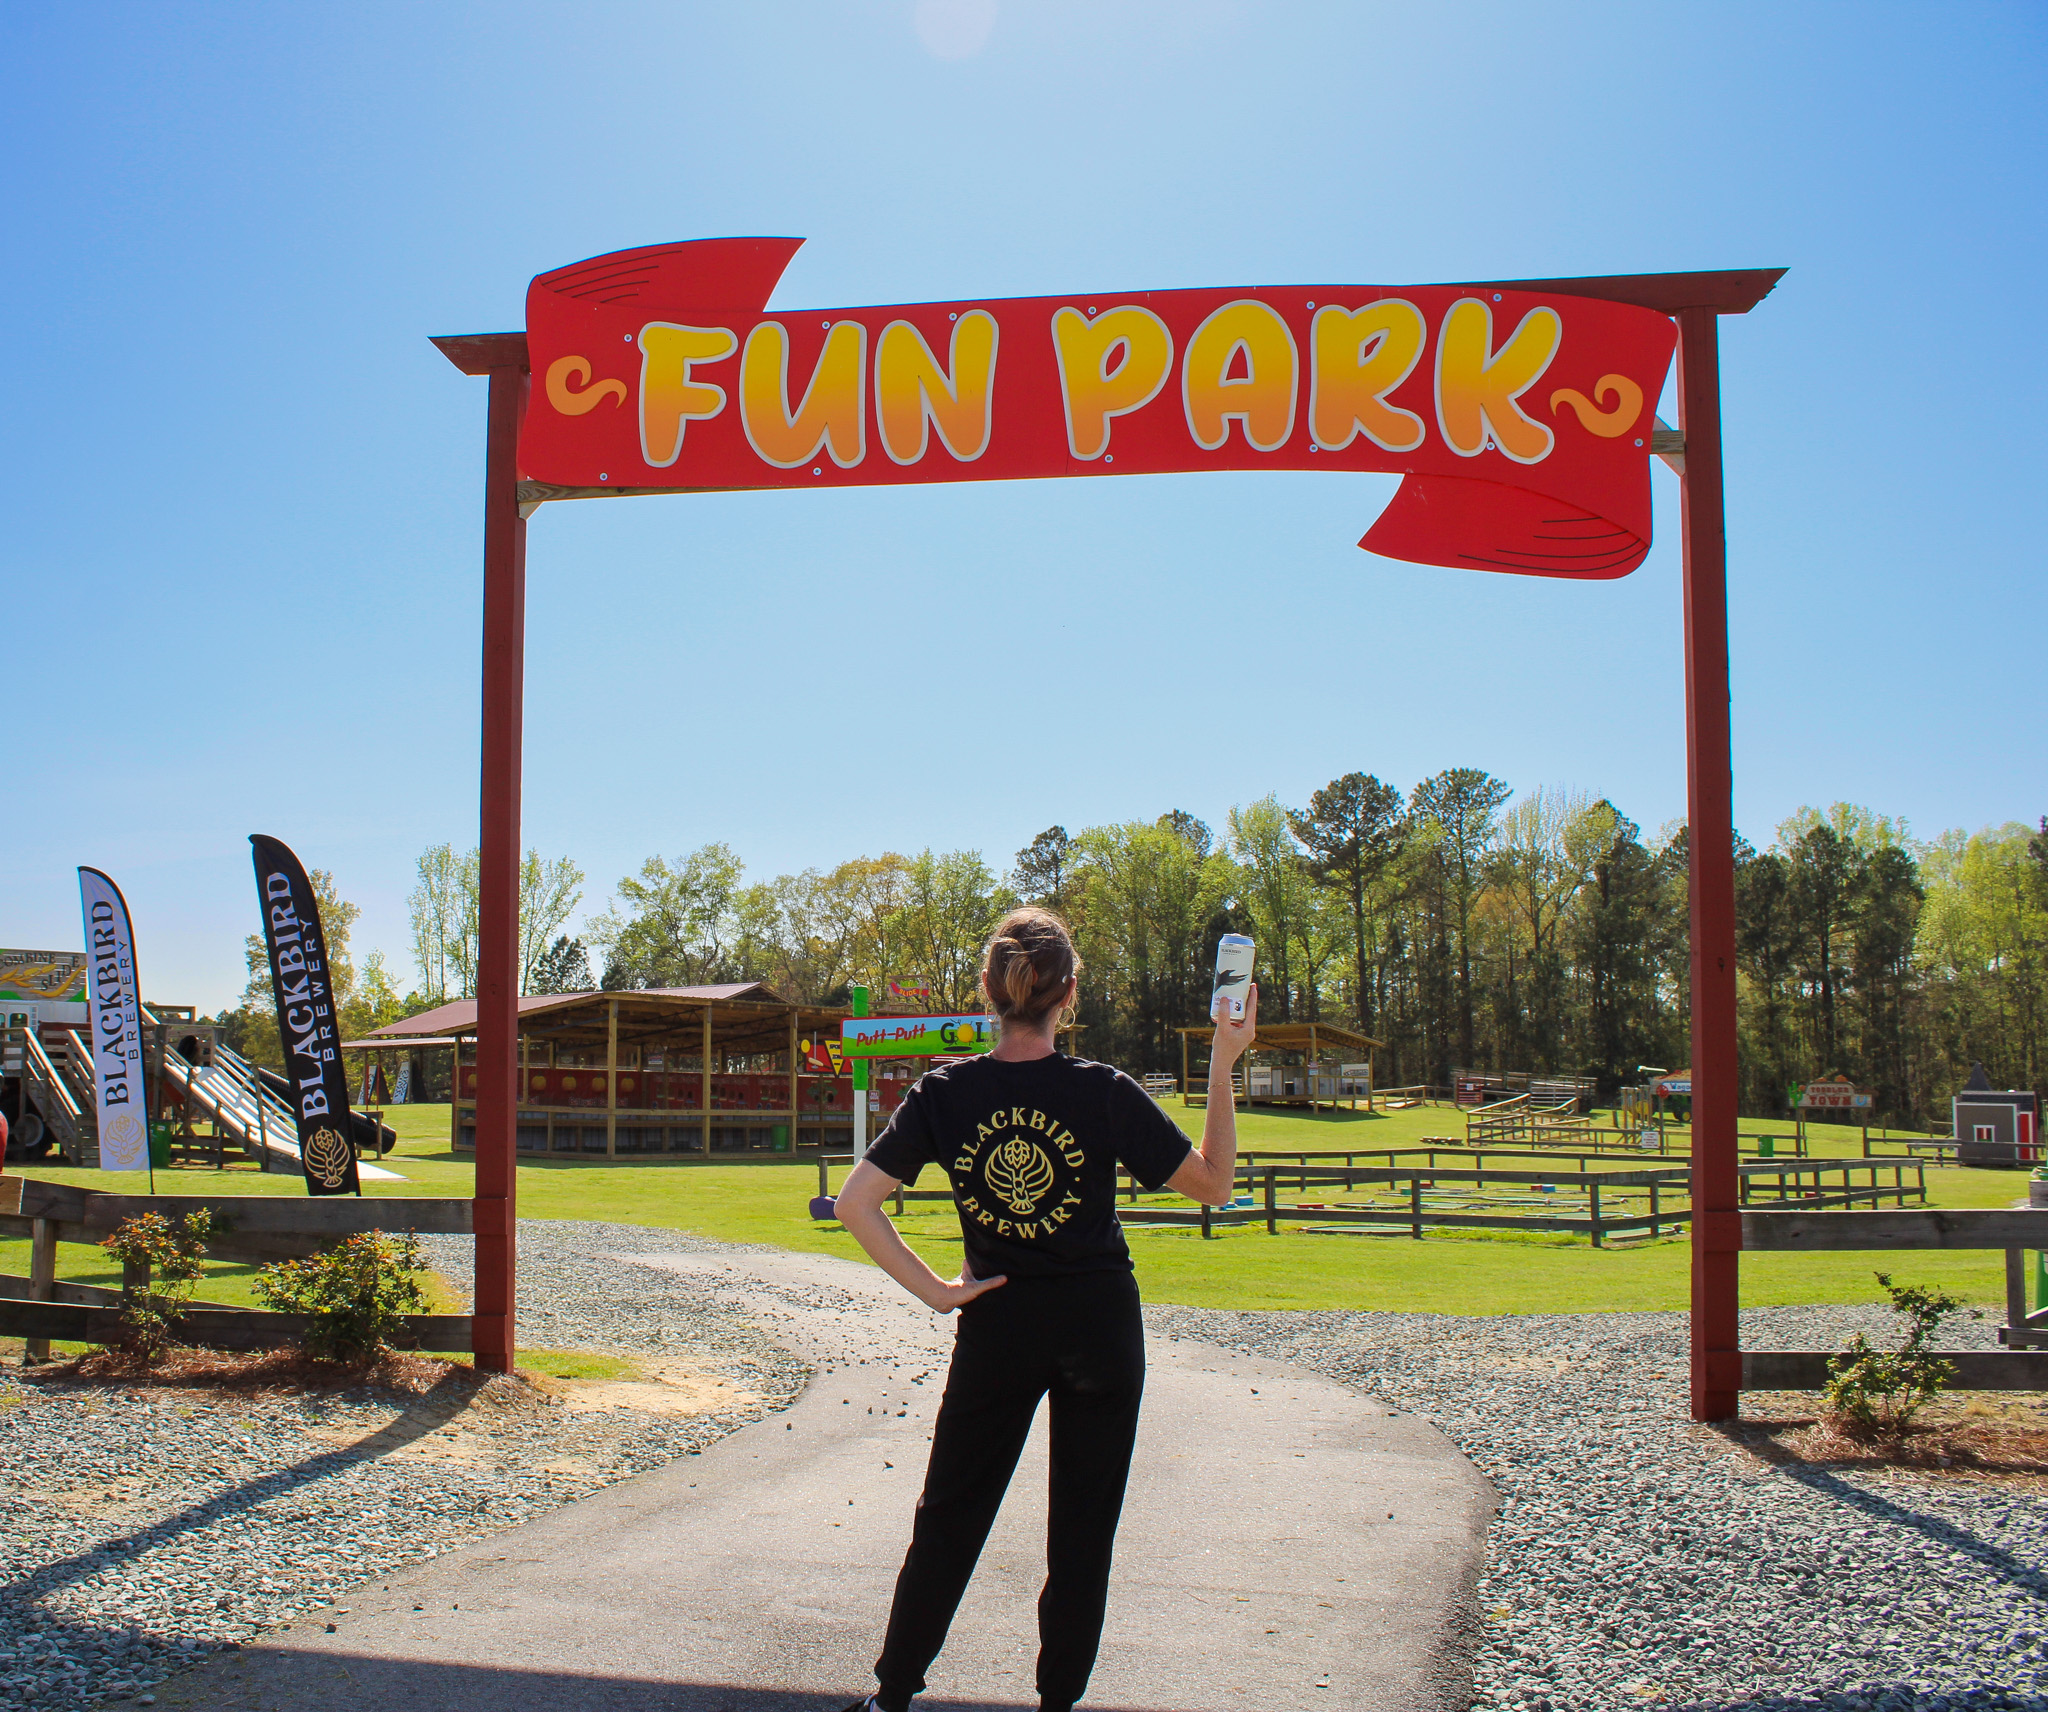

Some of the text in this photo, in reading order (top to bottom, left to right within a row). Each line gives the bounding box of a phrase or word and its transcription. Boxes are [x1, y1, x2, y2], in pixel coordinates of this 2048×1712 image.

[638, 297, 1562, 469] FUN PARK
[42, 956, 80, 991] SLIDE
[92, 901, 129, 1107] BLACKBIRD
[119, 941, 139, 1060] BREWERY
[266, 872, 330, 1120] BLACKBIRD
[300, 919, 335, 1062] BREWERY
[856, 1023, 926, 1047] Putt-Putt
[1670, 1082, 1691, 1091] Wago
[1809, 1096, 1851, 1105] TOWN
[954, 1107, 1085, 1172] BLACKBIRD
[962, 1189, 1082, 1239] BREWERY
